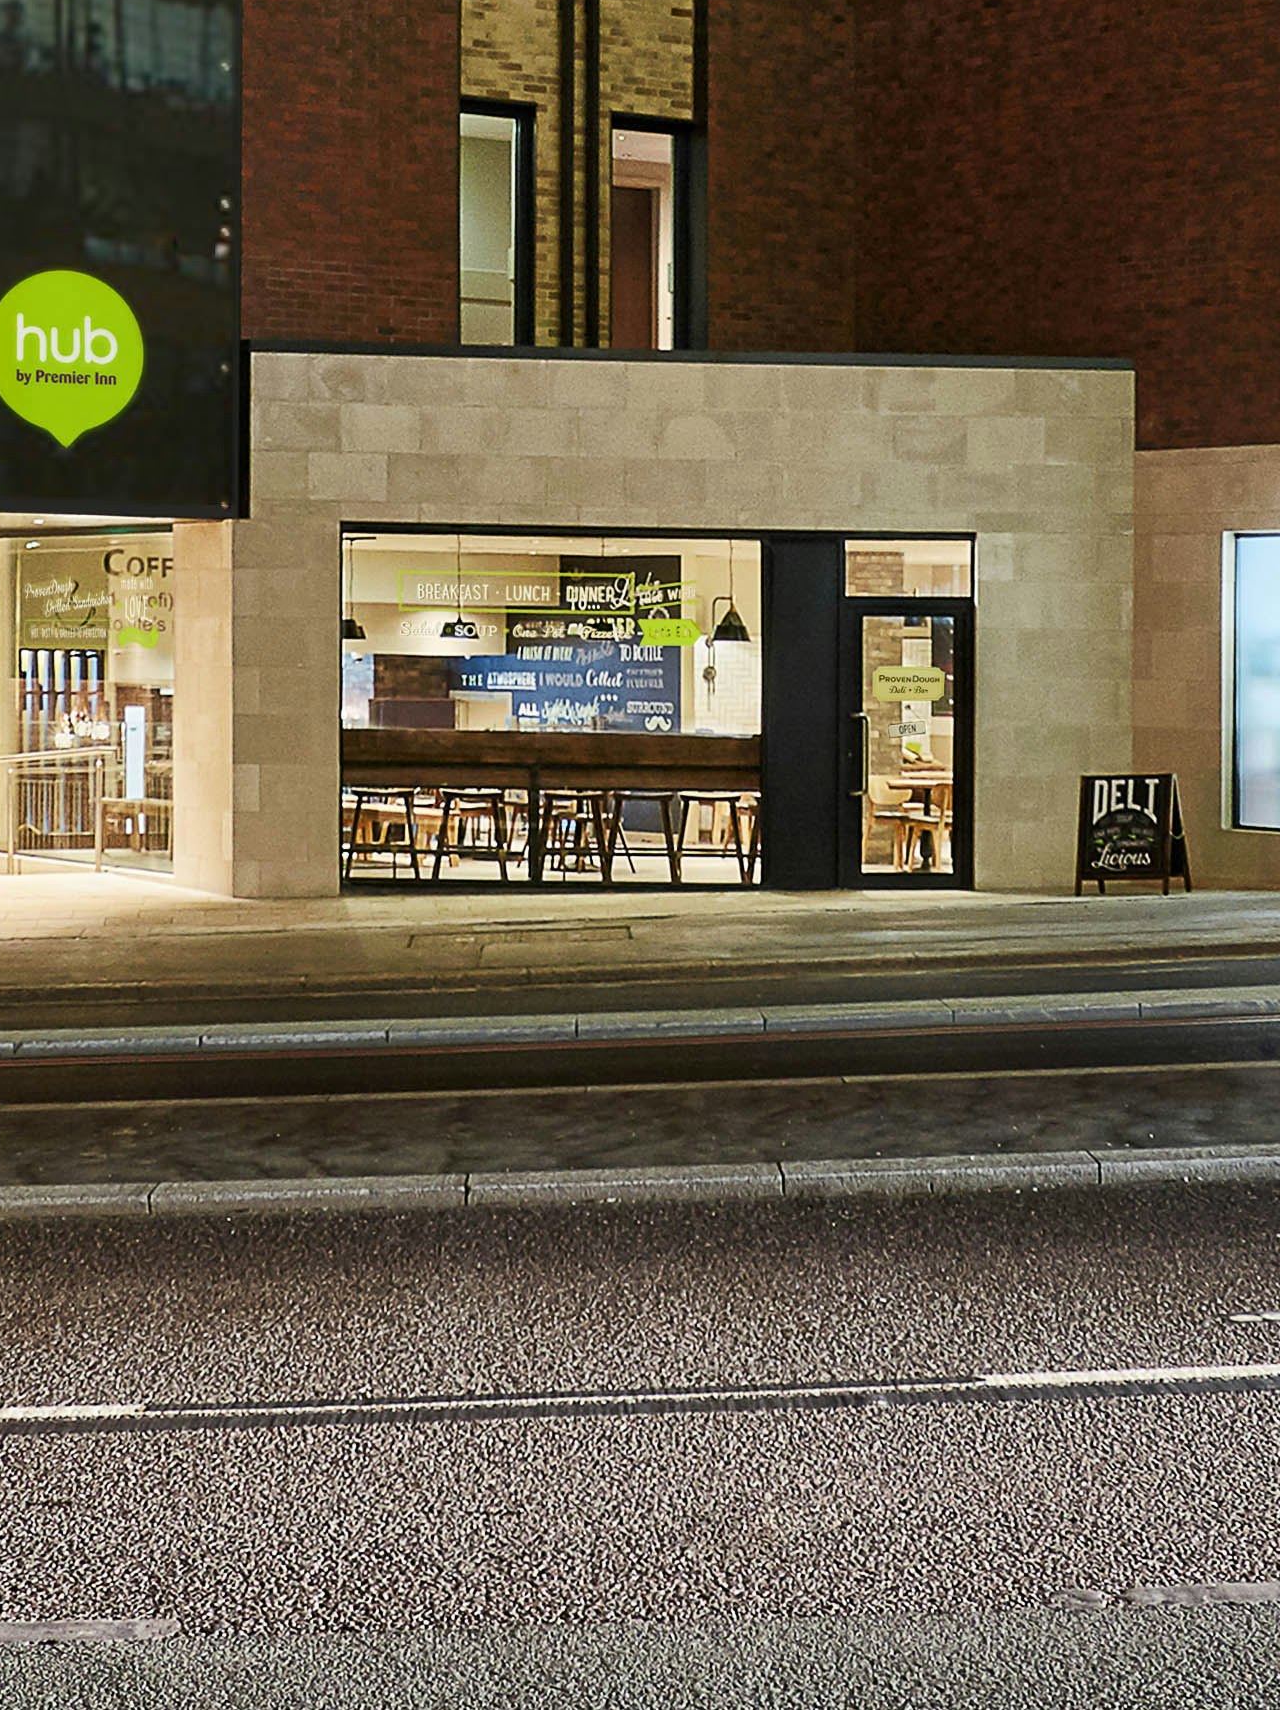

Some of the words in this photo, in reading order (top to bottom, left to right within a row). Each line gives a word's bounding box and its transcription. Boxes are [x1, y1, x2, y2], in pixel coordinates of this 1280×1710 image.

[16, 312, 118, 365] hub
[16, 369, 32, 385] by
[35, 369, 91, 384] Premier
[95, 372, 117, 385] Inn
[417, 583, 489, 601] BREAKFAST
[505, 584, 551, 602] LUNCH
[566, 585, 614, 603] DINNER
[454, 624, 498, 637] SOUP
[461, 674, 483, 687] THE
[487, 672, 536, 687] ATMOSPHERE
[545, 672, 583, 687] WOULD
[518, 702, 540, 716] ALL
[898, 723, 917, 735] OPEN
[1092, 779, 1160, 825] DELI
[1091, 842, 1151, 872] Licious
